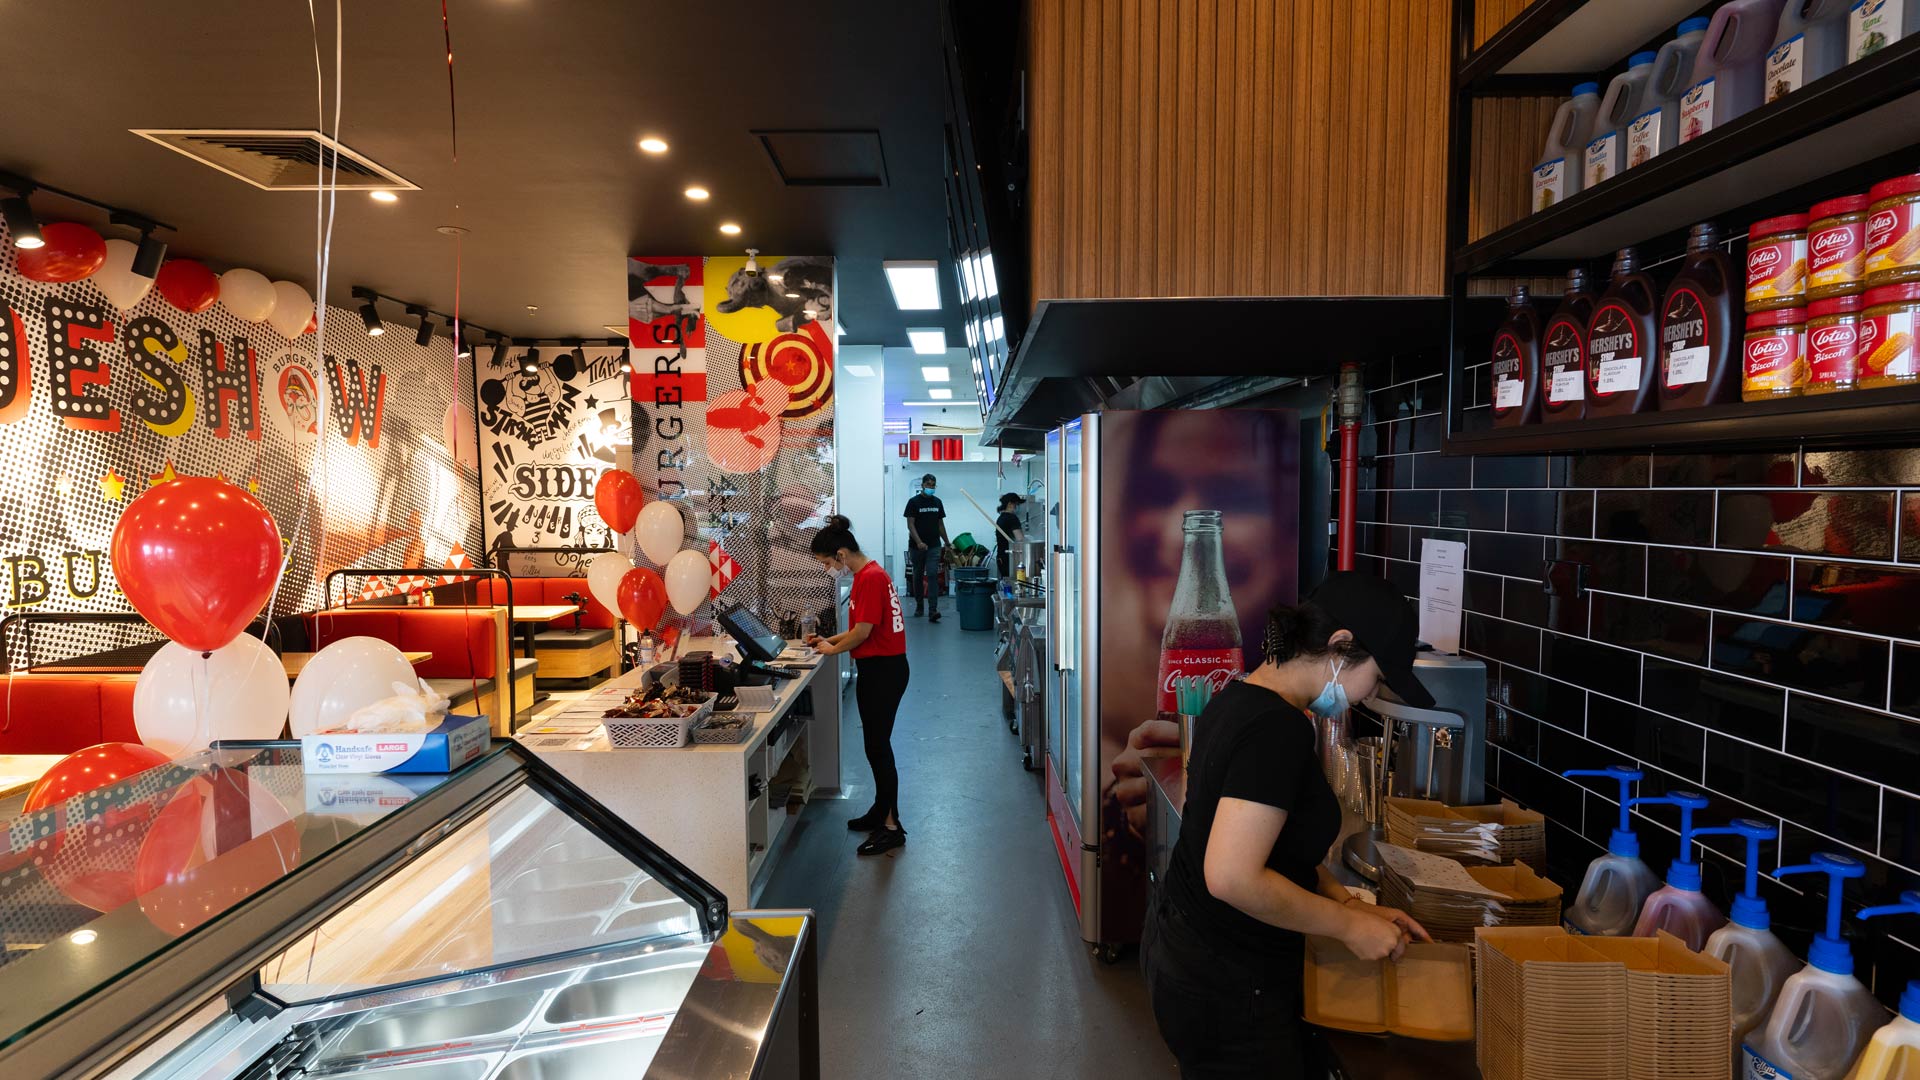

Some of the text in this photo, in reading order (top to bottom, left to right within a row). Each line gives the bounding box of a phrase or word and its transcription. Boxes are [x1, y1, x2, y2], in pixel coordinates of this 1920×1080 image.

[1768, 58, 1797, 80] Chocolate
[1632, 131, 1650, 144] Coffee
[1535, 175, 1558, 188] Caramel
[1815, 233, 1848, 250] Lotus
[1750, 251, 1777, 267] Lotus
[1812, 249, 1848, 269] Biscoff
[1748, 266, 1776, 285] Biscoff
[1664, 319, 1703, 343] HERSHEY'S
[1816, 329, 1851, 346] Lotus
[1590, 333, 1633, 355] HERSHEY'S
[1752, 342, 1783, 357] Lotus
[1545, 347, 1580, 367] HERSHEY'S
[1813, 347, 1850, 364] Biscoff
[272, 353, 319, 379] BURGERS
[1750, 358, 1783, 374] Biscoff
[1819, 371, 1837, 380] SPREAD
[652, 322, 685, 506] URGERS
[335, 744, 406, 753] Handsafe LARGE
[1751, 1054, 1776, 1075] Edlyn
